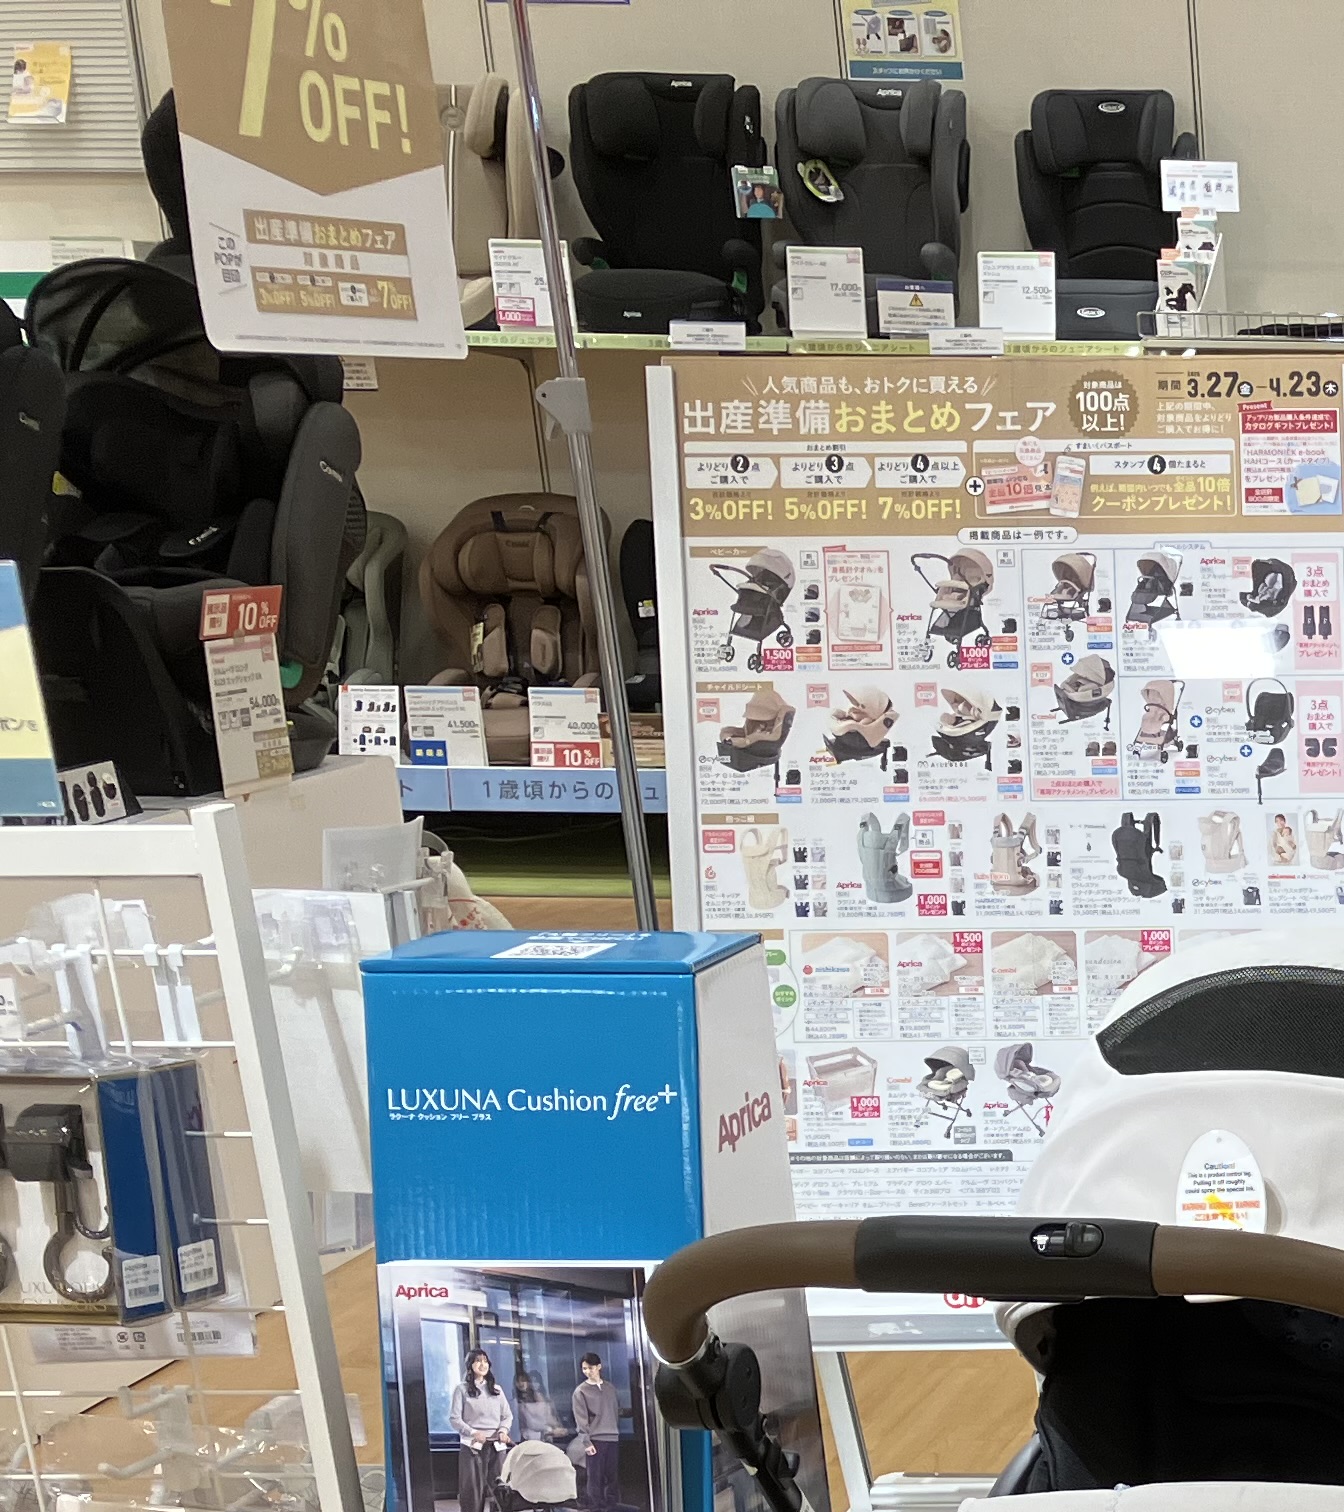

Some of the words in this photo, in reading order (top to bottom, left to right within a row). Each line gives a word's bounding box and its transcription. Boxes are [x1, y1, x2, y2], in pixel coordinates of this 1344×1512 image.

[299, 69, 411, 154] OFF!
[763, 376, 978, 395] 人気商品も、おトクに買える
[1158, 380, 1181, 390] 期間
[1076, 391, 1130, 412] 100点
[683, 399, 1056, 436] 出産準備おまとめフェア
[710, 475, 748, 485] ご購入で
[805, 475, 843, 485] ご購入で
[900, 474, 937, 484] ご購入で
[689, 498, 773, 521] 3%OFF!
[785, 497, 867, 520] 5%OFF!
[881, 497, 961, 520] 7%OFF!
[1091, 495, 1232, 512] クーポンプレゼント!
[969, 530, 1070, 541] 掲載商品は一例です。
[1306, 566, 1324, 577] 3点
[259, 614, 277, 629] OFF
[1311, 700, 1328, 710] 3点
[387, 1088, 501, 1111] LUXUNA
[508, 1088, 607, 1111] Cushion
[718, 1088, 772, 1153] Aprica
[395, 1283, 449, 1300] Aprica
